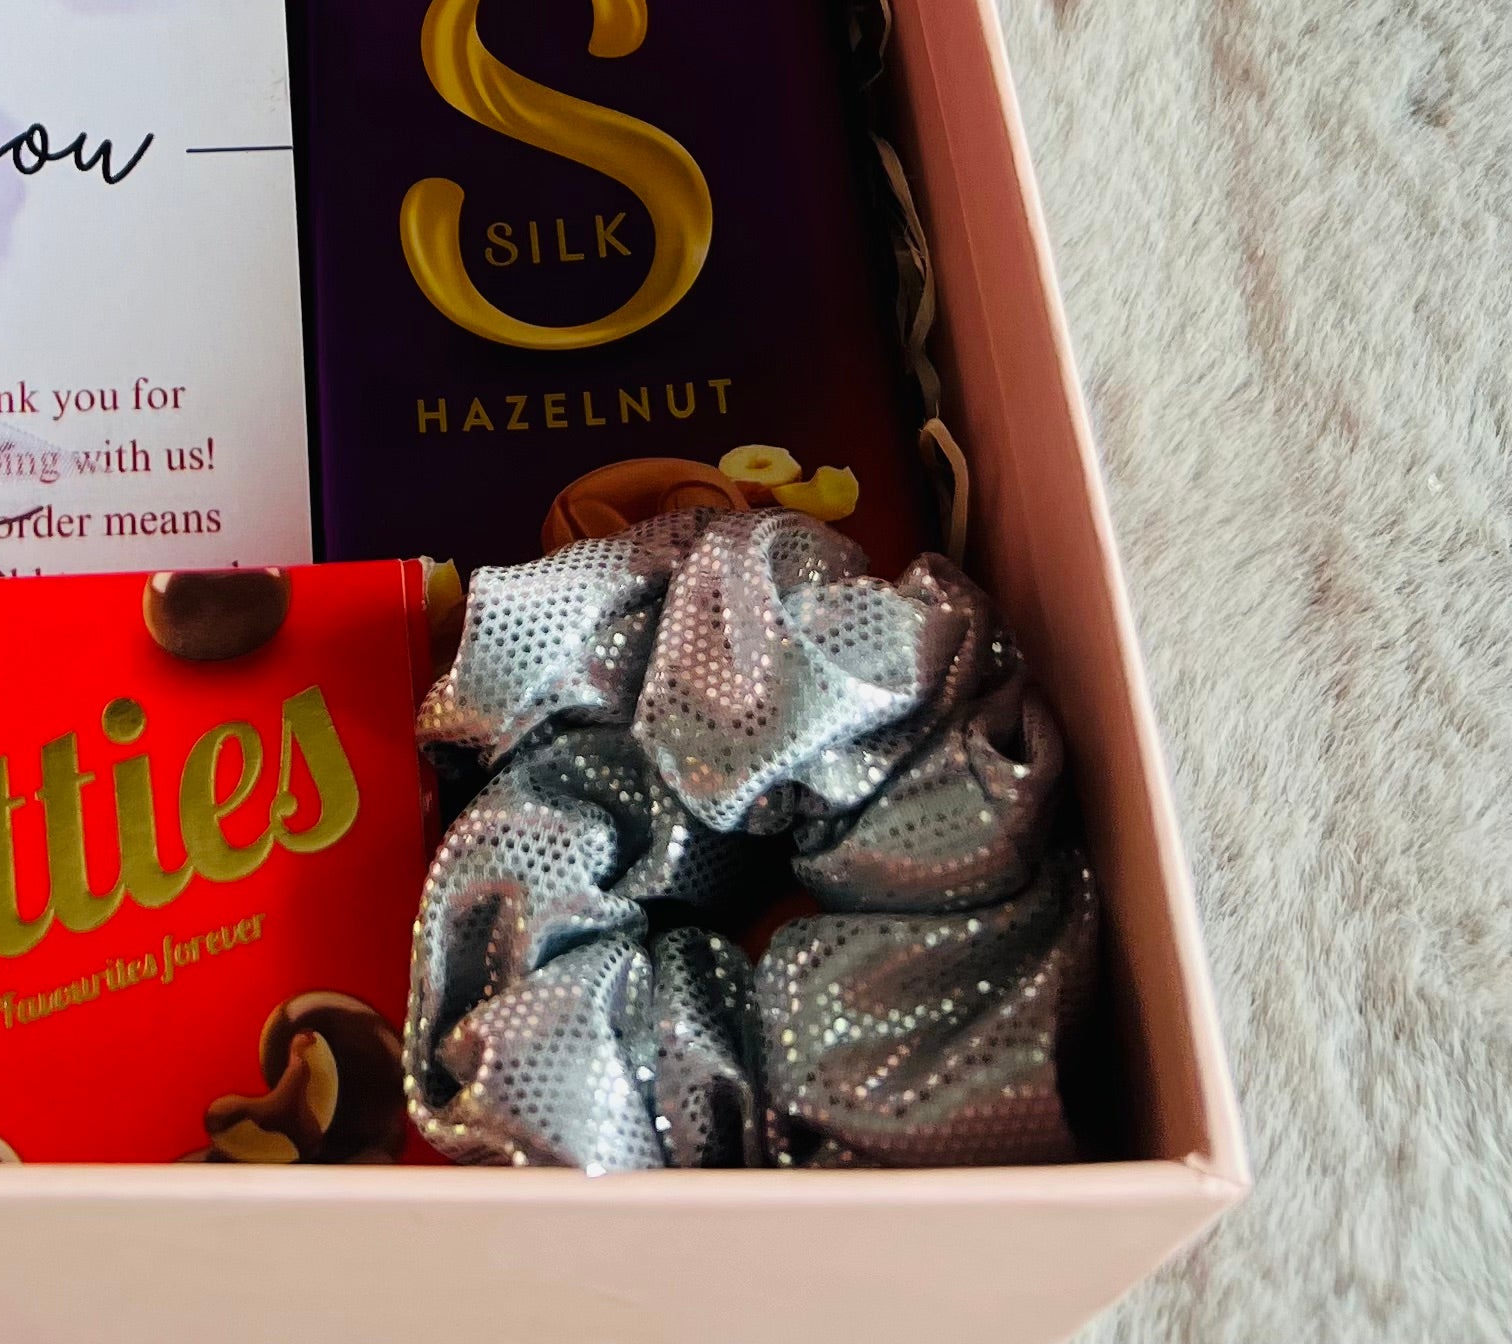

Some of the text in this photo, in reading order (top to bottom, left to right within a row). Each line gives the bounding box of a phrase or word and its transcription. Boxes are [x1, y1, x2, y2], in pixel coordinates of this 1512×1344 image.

[484, 211, 632, 267] SILK
[52, 386, 120, 421] you
[132, 377, 187, 412] for
[416, 377, 733, 434] HAZELNUT
[73, 439, 152, 473] with
[166, 436, 217, 473] us!
[104, 508, 223, 536] means
[160, 913, 266, 985] forever
